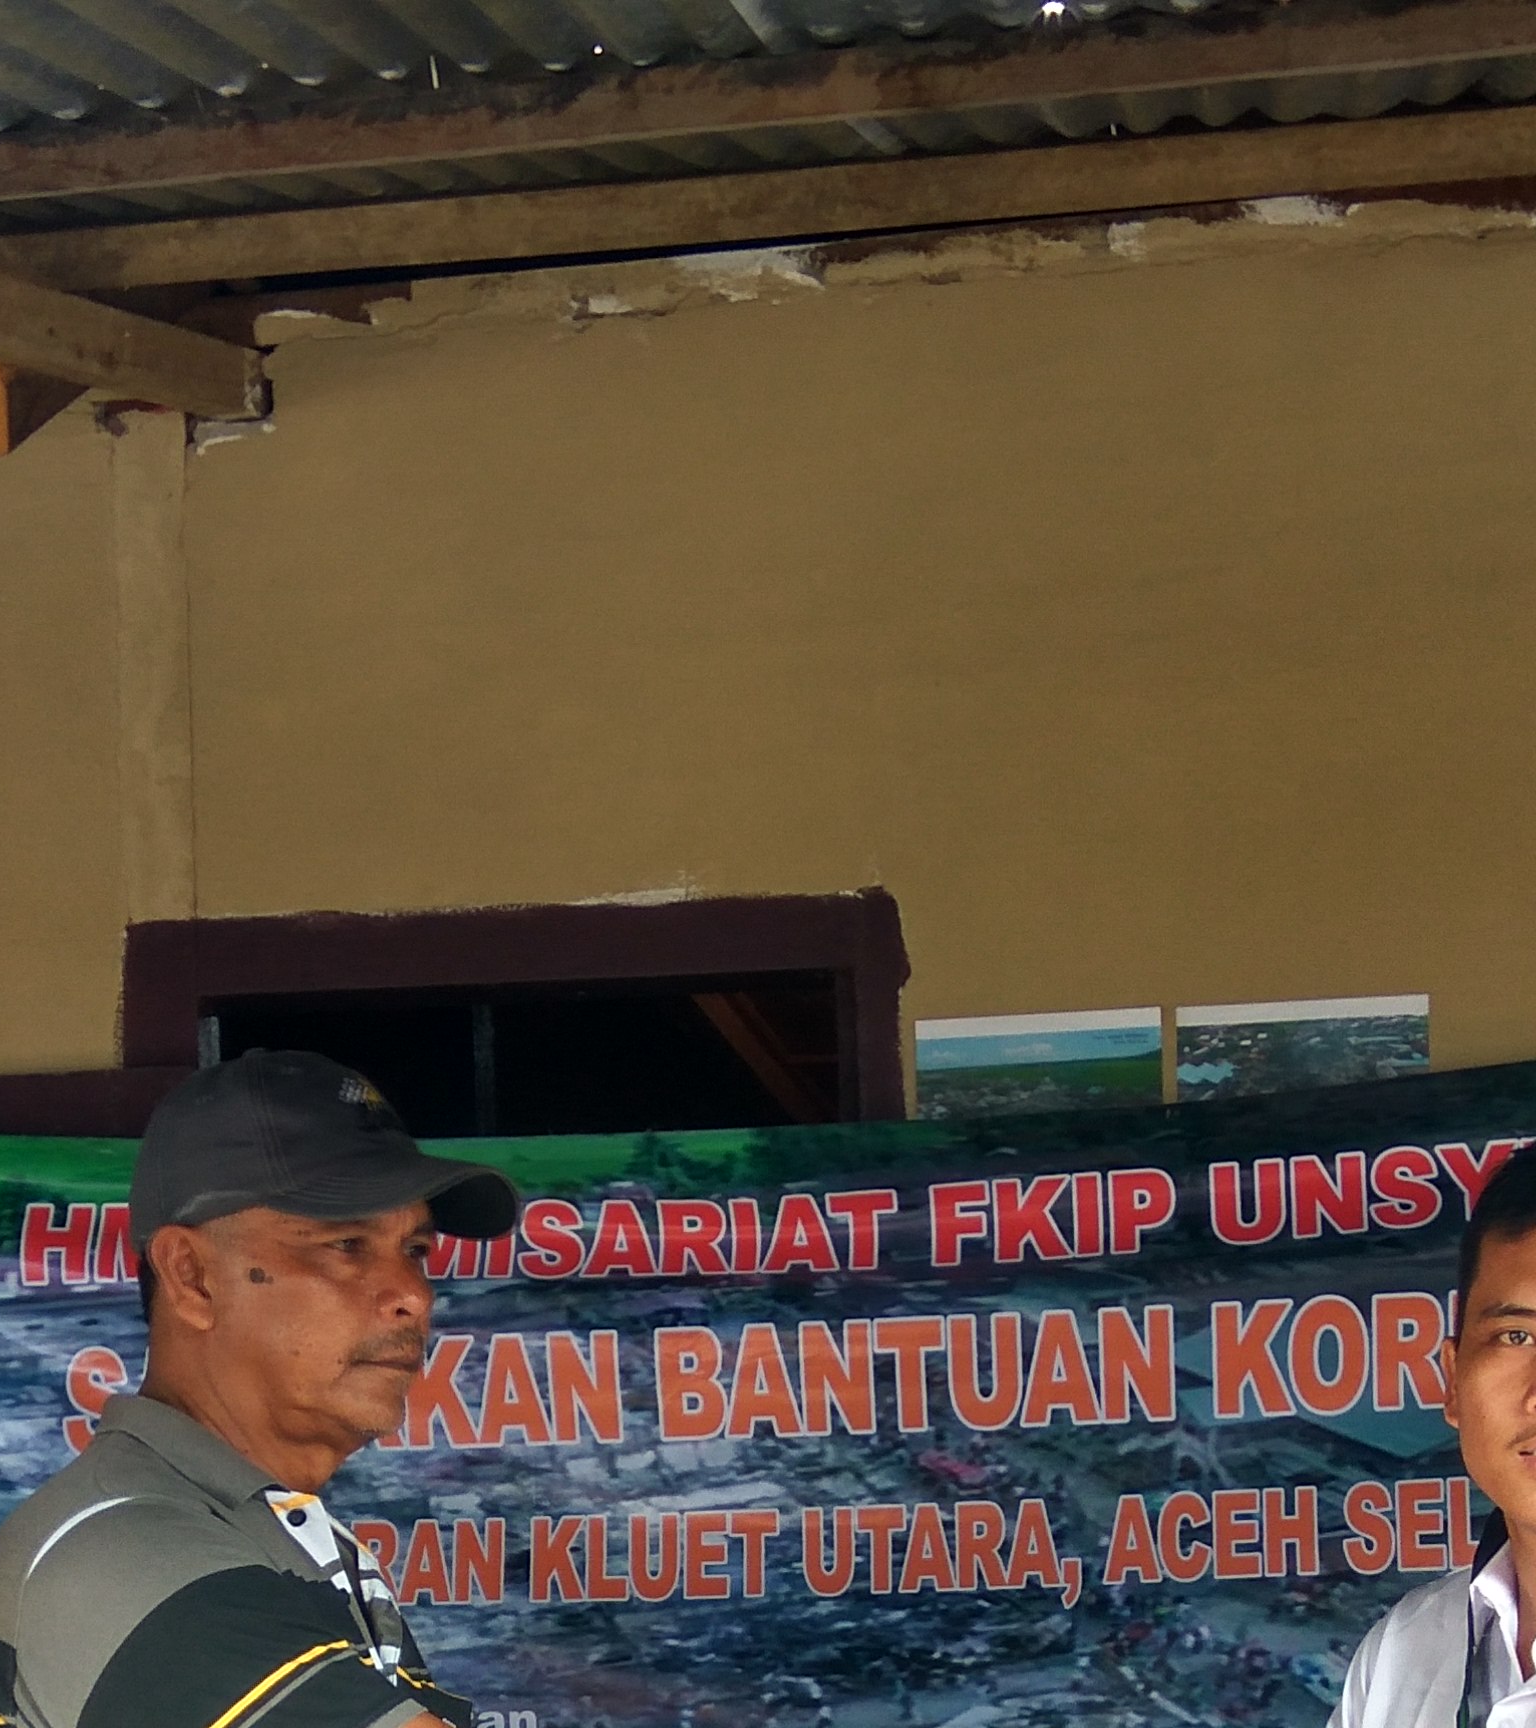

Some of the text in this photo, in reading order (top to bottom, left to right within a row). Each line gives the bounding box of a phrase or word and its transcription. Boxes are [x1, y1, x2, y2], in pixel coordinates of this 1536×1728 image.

[931, 1167, 1176, 1268] FKIP
[654, 1305, 1176, 1443] BANTUAN
[1211, 1292, 1460, 1418] KOR
[353, 1516, 504, 1606] RAN
[529, 1508, 779, 1604] KLUET
[801, 1498, 1082, 1608] UTARA,
[1104, 1485, 1323, 1586] ACEH
